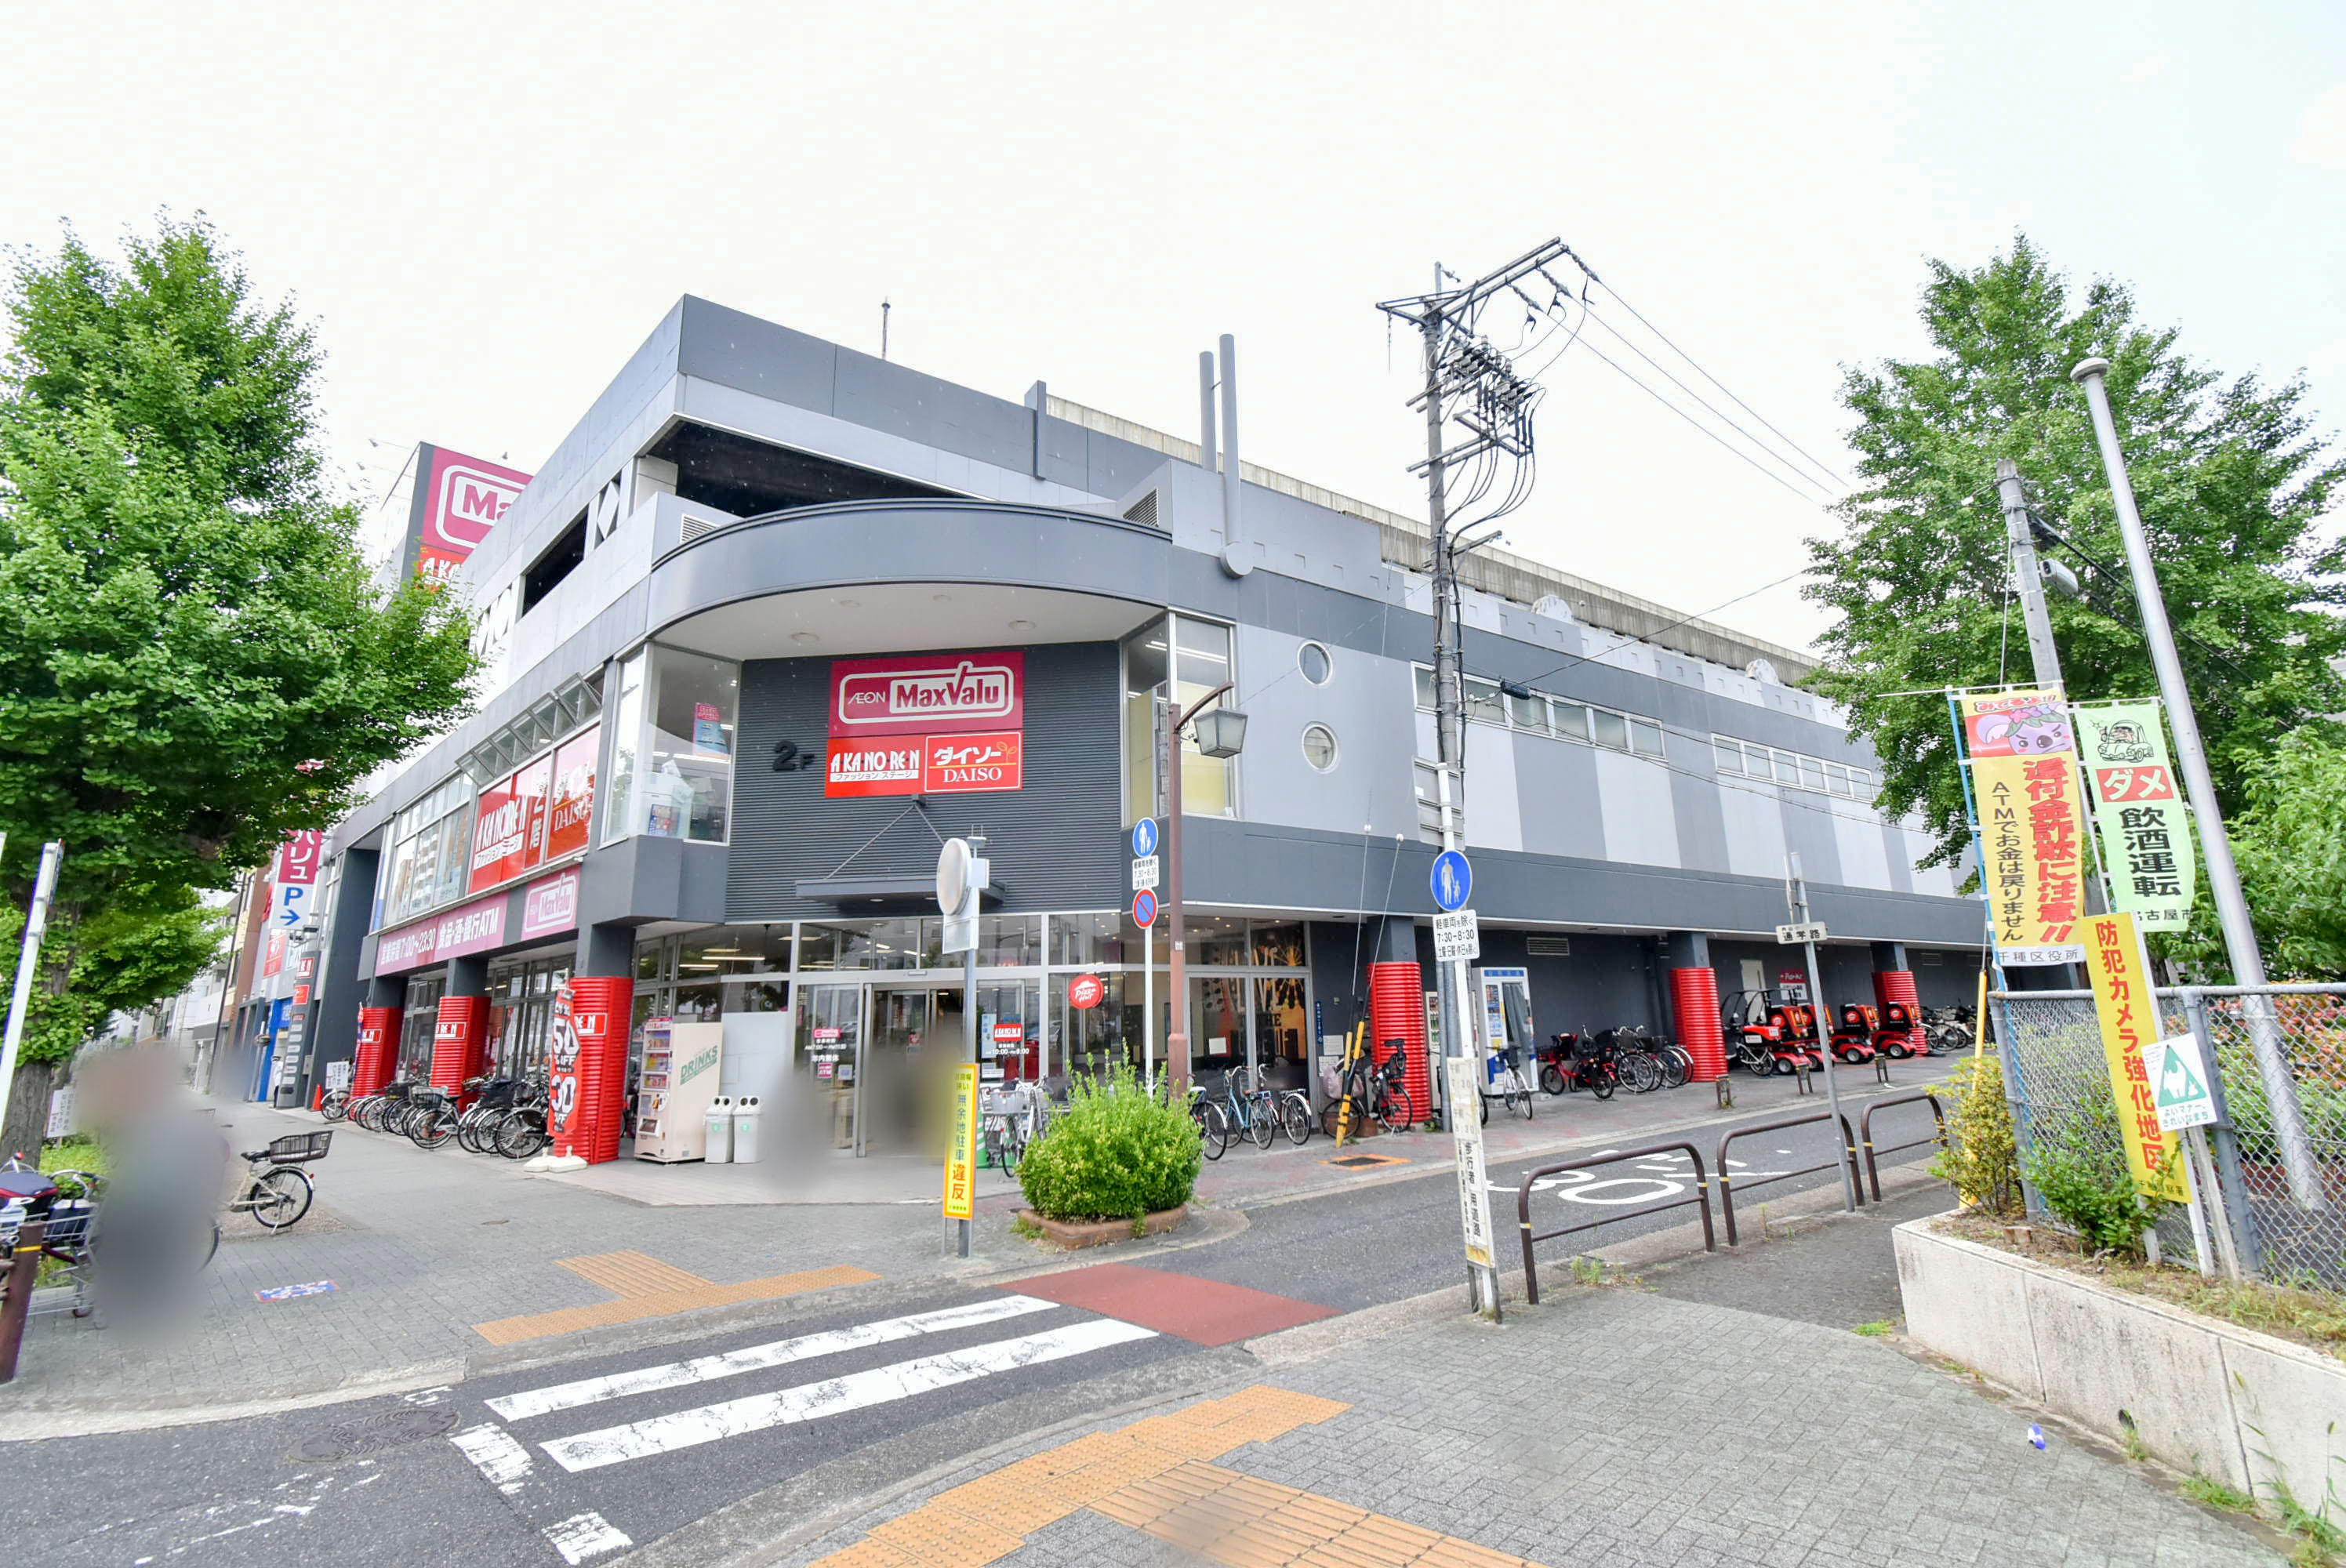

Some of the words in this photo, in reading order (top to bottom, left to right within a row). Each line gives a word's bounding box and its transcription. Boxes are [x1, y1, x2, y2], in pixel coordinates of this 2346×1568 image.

[896, 666, 1000, 708] MaxValu
[934, 746, 1002, 766] ダイソー
[943, 768, 1003, 783] DAISO
[2104, 768, 2167, 800] ダメ
[1992, 781, 2026, 942] ATMでお金は戻りません
[2119, 807, 2182, 898] 飲酒運転
[284, 887, 303, 906] P
[1436, 915, 1473, 930] 軽車両を除く
[1999, 949, 2078, 963] 千種区役所
[680, 1044, 718, 1079] DRINKS
[2095, 920, 2169, 1172] 防犯カメラ強化地区
